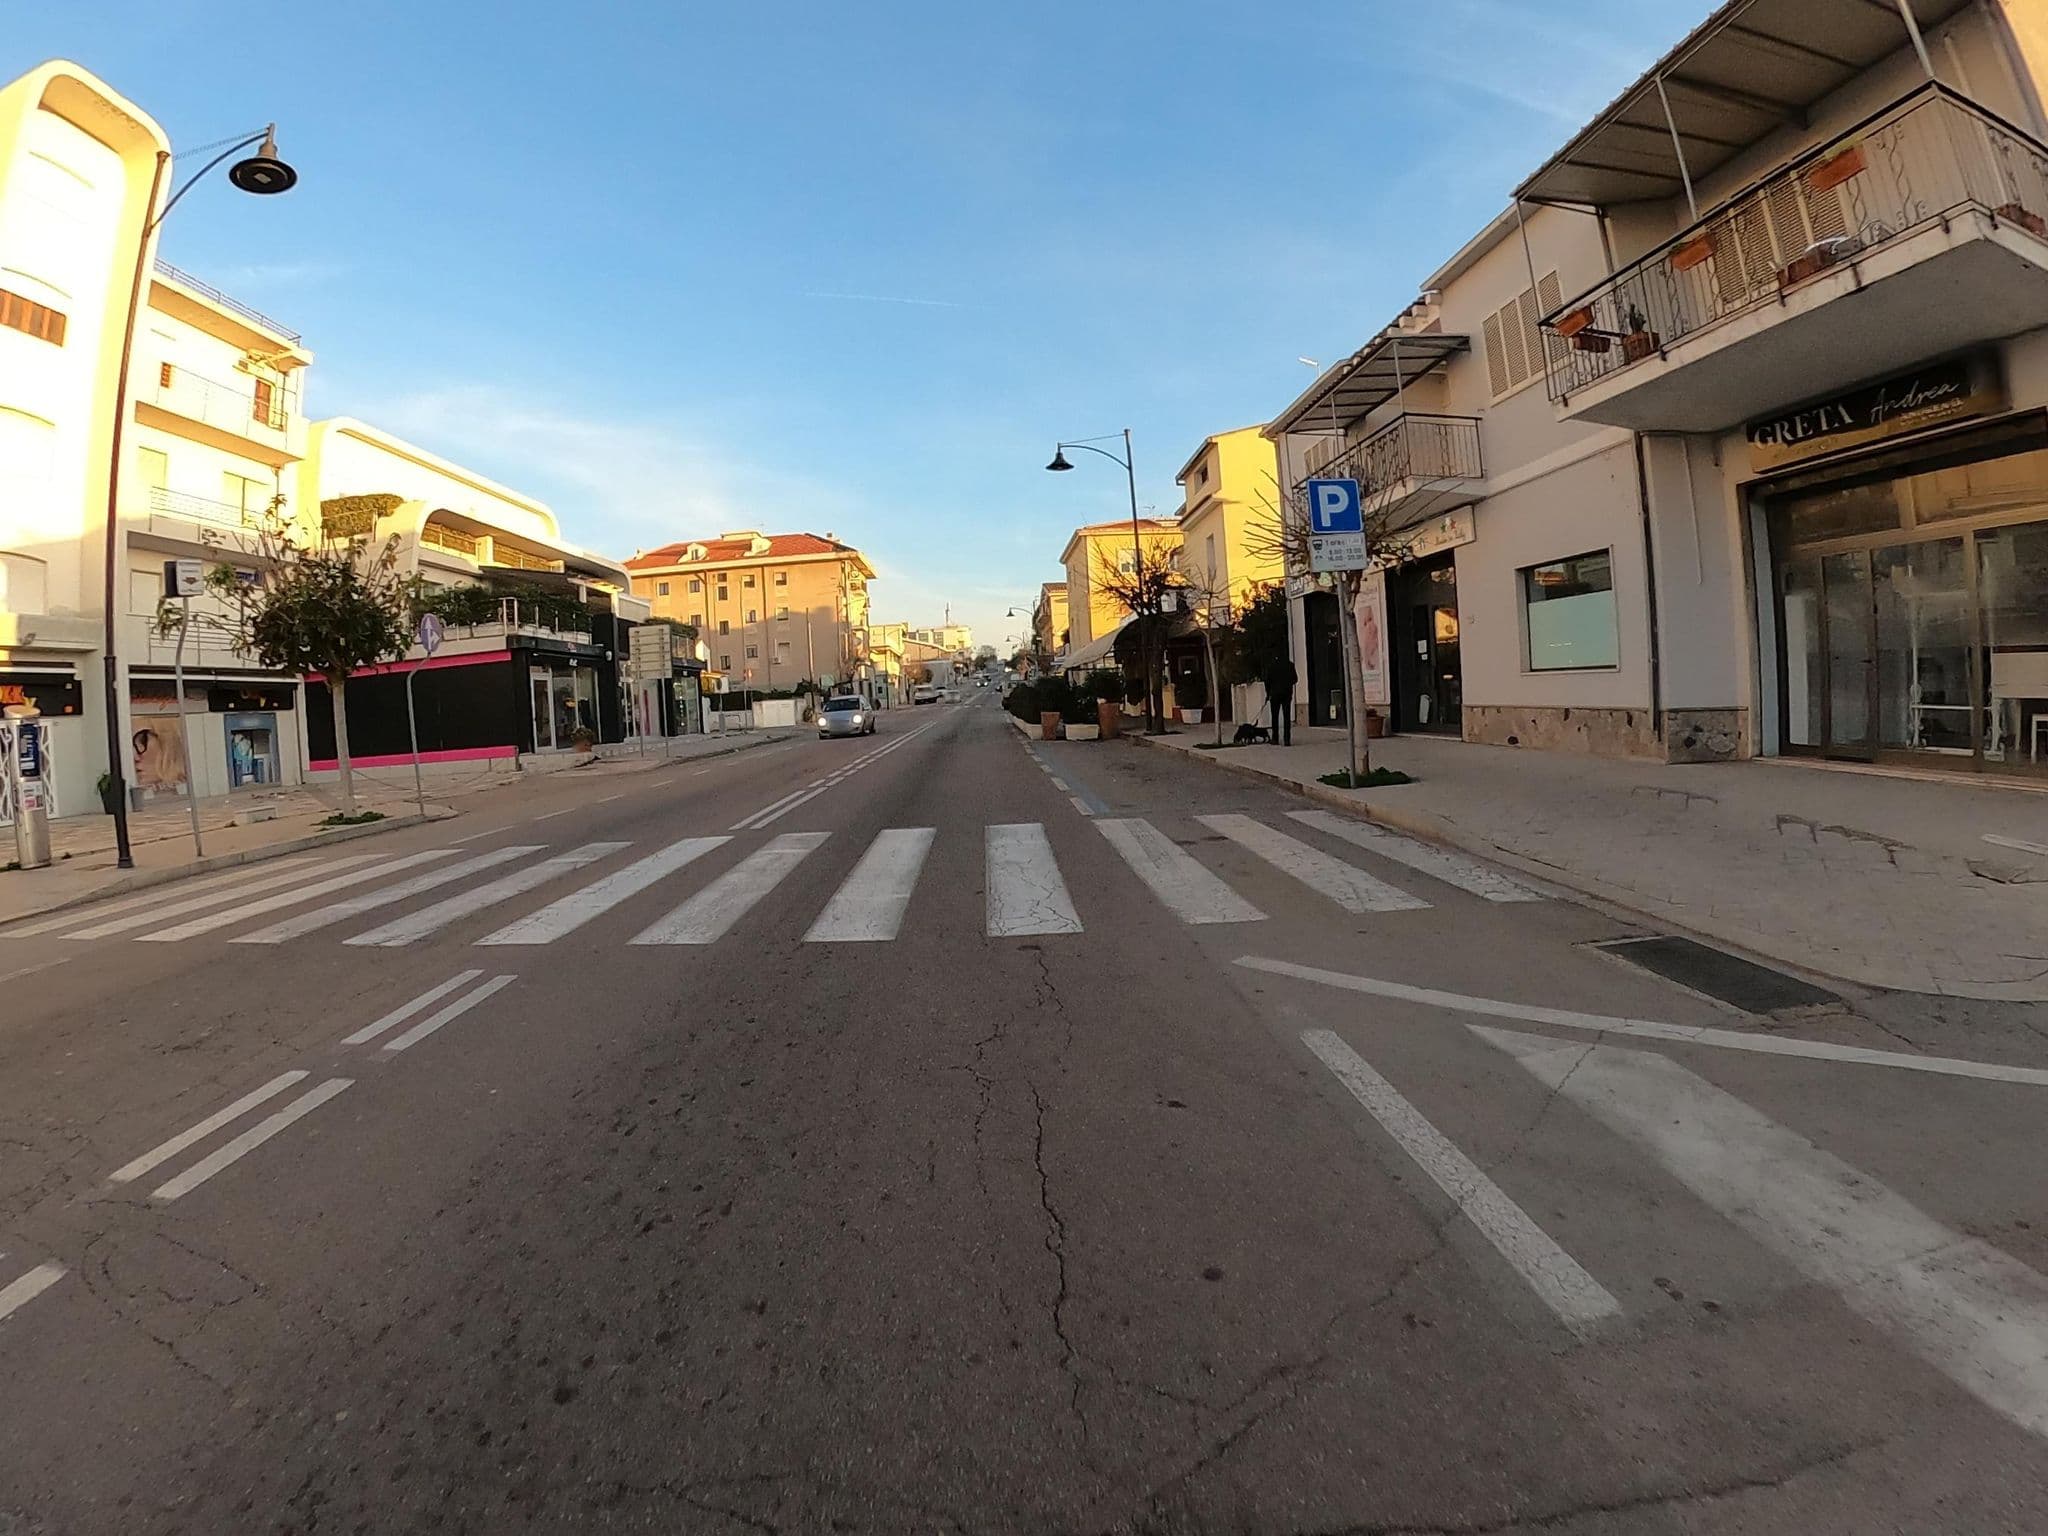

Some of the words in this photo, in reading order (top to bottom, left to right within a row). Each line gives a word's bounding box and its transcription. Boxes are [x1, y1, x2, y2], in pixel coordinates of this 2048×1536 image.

[1754, 403, 1855, 450] GRETA
[1870, 380, 1960, 424] Andrea
[1317, 484, 1350, 527] P
